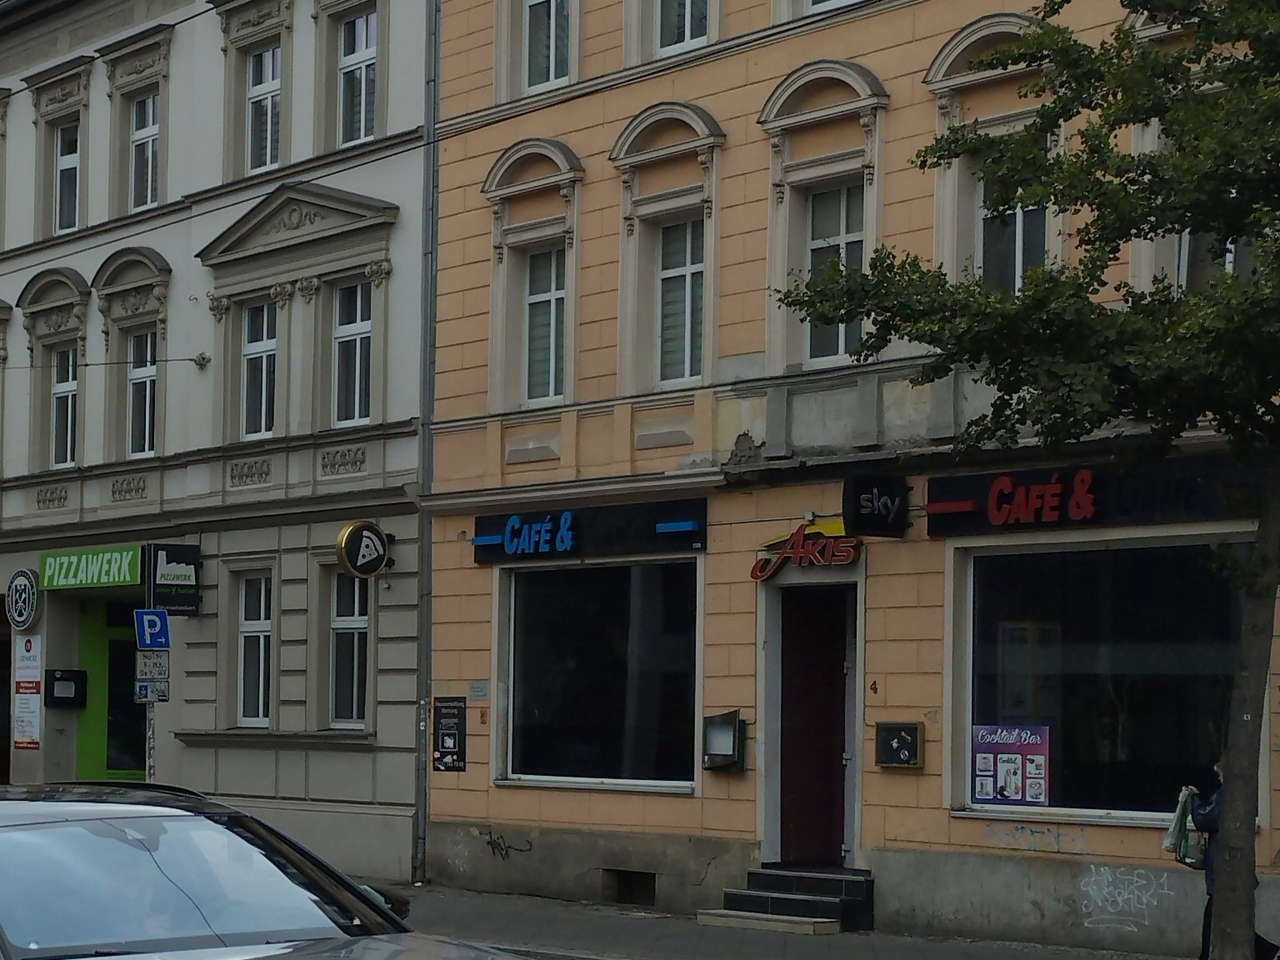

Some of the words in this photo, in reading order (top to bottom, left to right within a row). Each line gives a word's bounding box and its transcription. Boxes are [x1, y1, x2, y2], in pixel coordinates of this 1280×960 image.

[860, 487, 900, 522] sky
[987, 473, 1062, 525] CAFÉ
[1068, 469, 1095, 520] &
[504, 515, 553, 555] CAFÉ
[556, 511, 573, 552] &
[43, 551, 134, 587] PIZZAWERK
[750, 524, 857, 581] AKIS
[143, 614, 161, 644] P
[978, 728, 1019, 745] Cocktail
[1021, 729, 1041, 744] Bar
